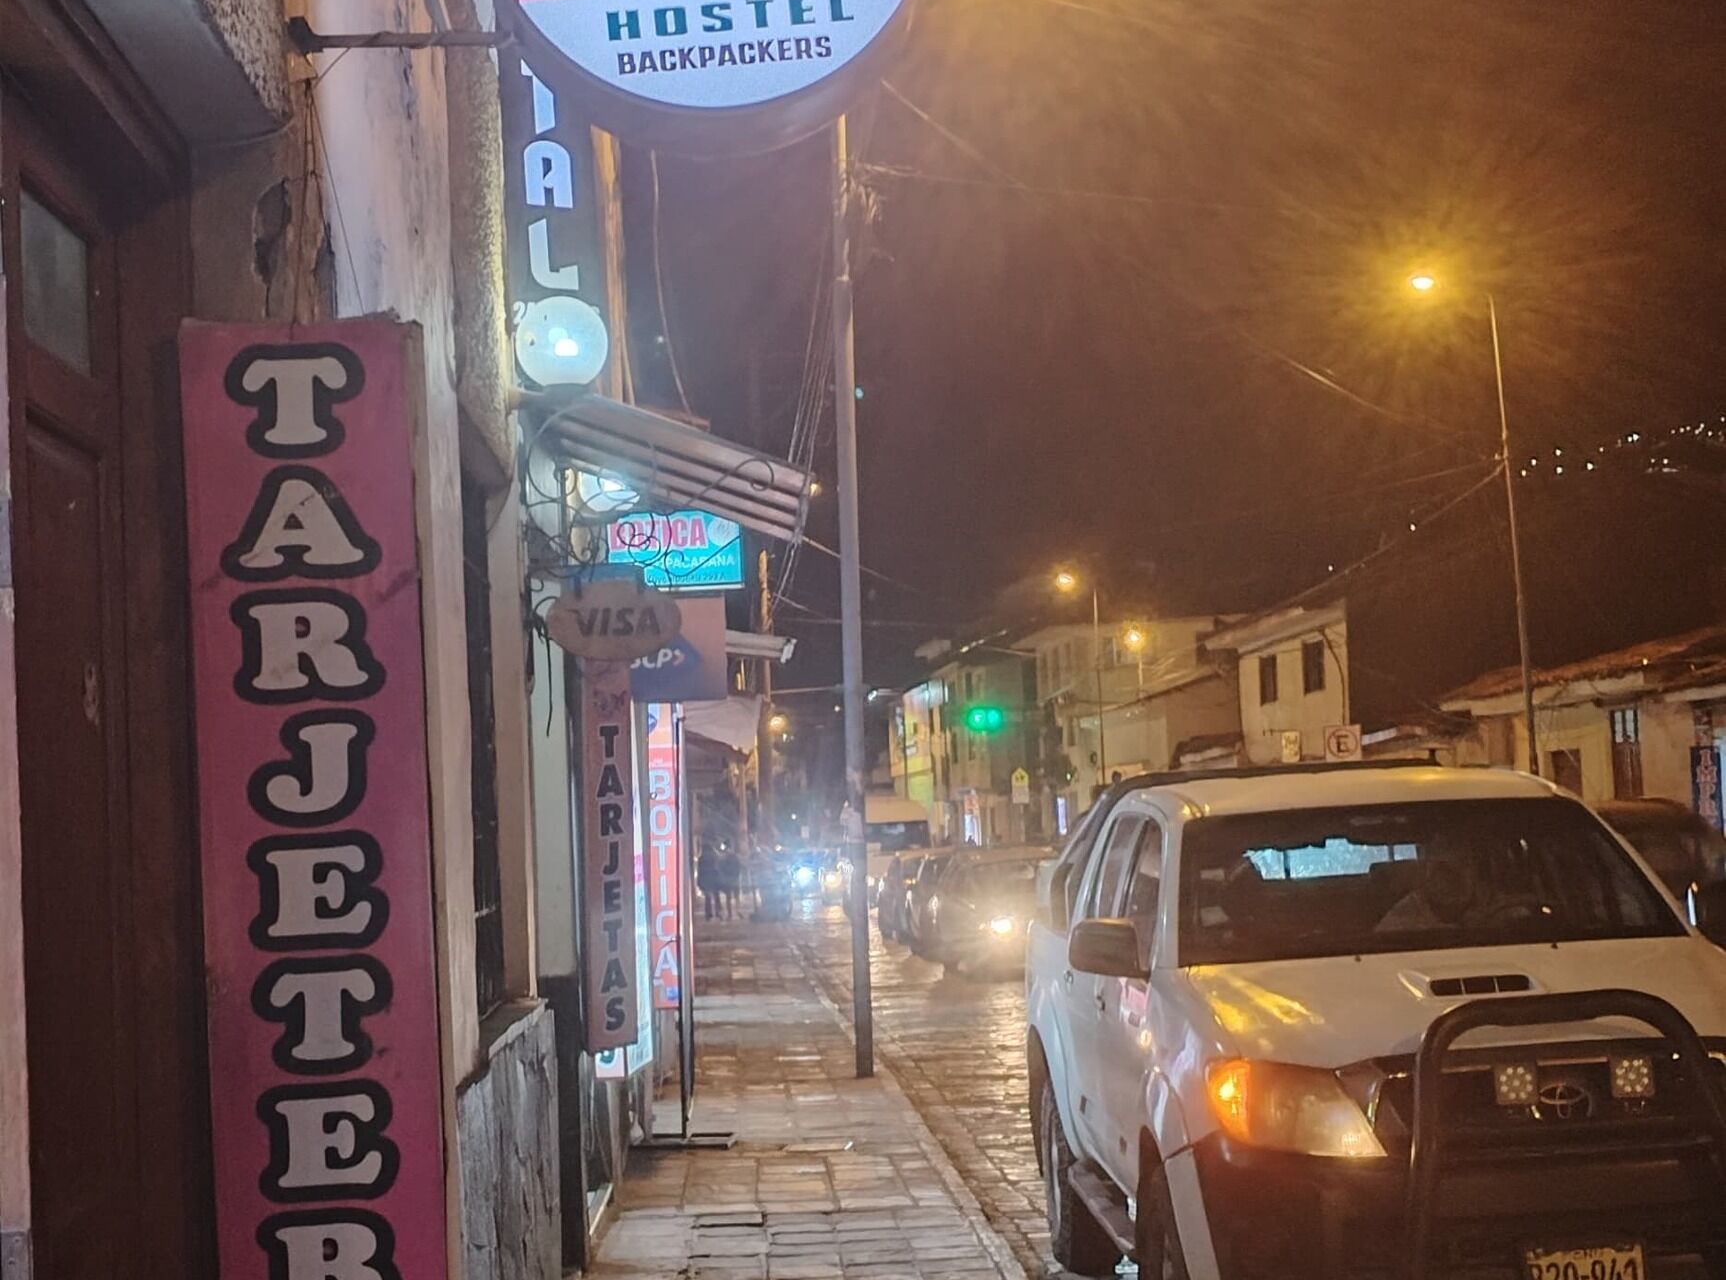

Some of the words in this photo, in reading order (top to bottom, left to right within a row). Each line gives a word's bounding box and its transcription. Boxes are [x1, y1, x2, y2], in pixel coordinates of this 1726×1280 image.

[617, 36, 832, 75] BACKPACKERS
[609, 517, 707, 551] BOTICA
[571, 606, 661, 638] VISA
[596, 724, 628, 1032] TARJETAS
[649, 768, 678, 978] BOTICA
